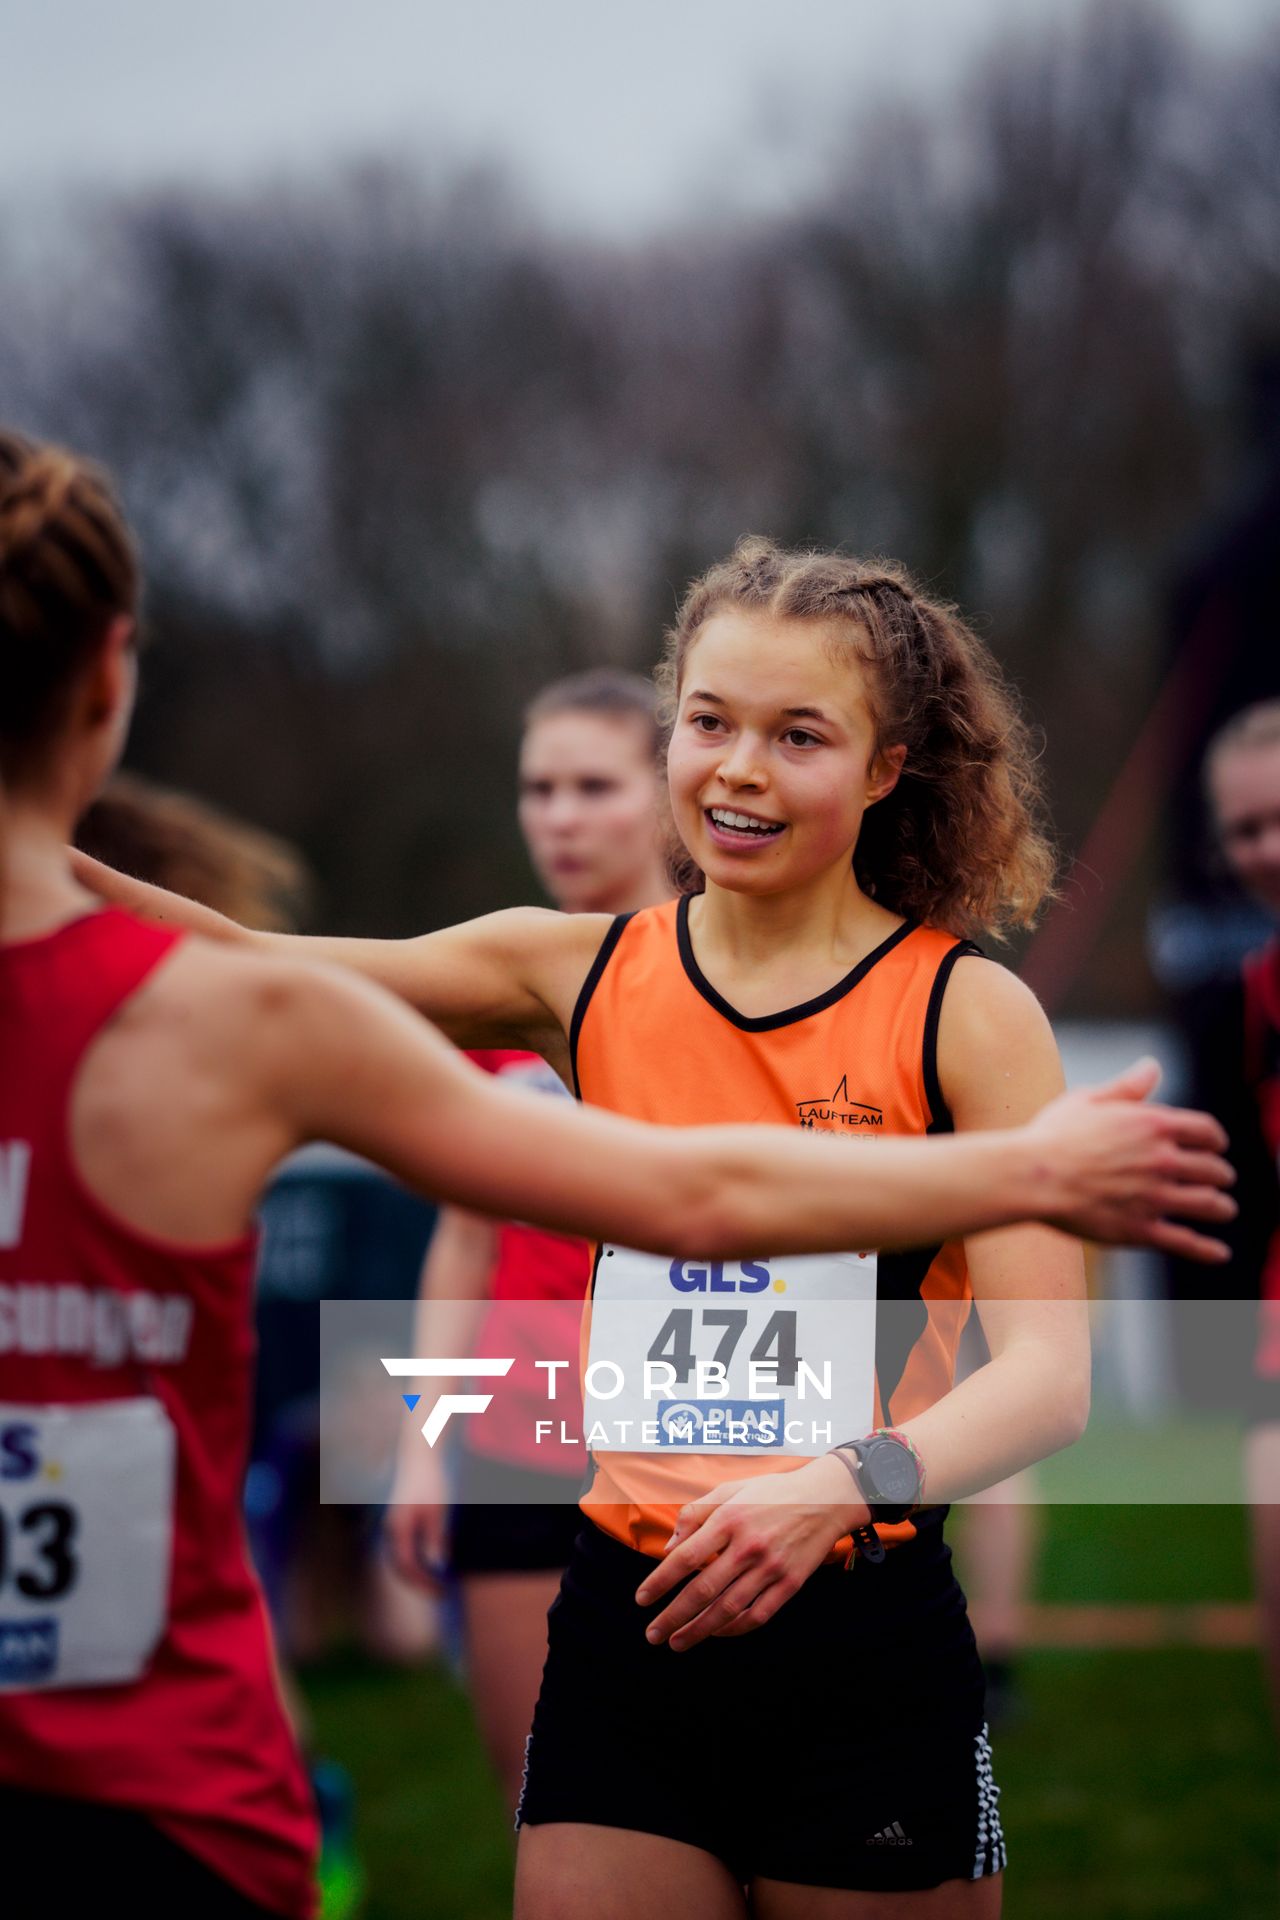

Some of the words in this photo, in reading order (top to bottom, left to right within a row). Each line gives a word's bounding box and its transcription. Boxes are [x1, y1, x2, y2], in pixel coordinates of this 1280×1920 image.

[798, 1107, 883, 1126] LAUFTEAM
[647, 1308, 803, 1387] 474
[708, 1408, 779, 1430] PLAN
[866, 1837, 913, 1846] adidas
